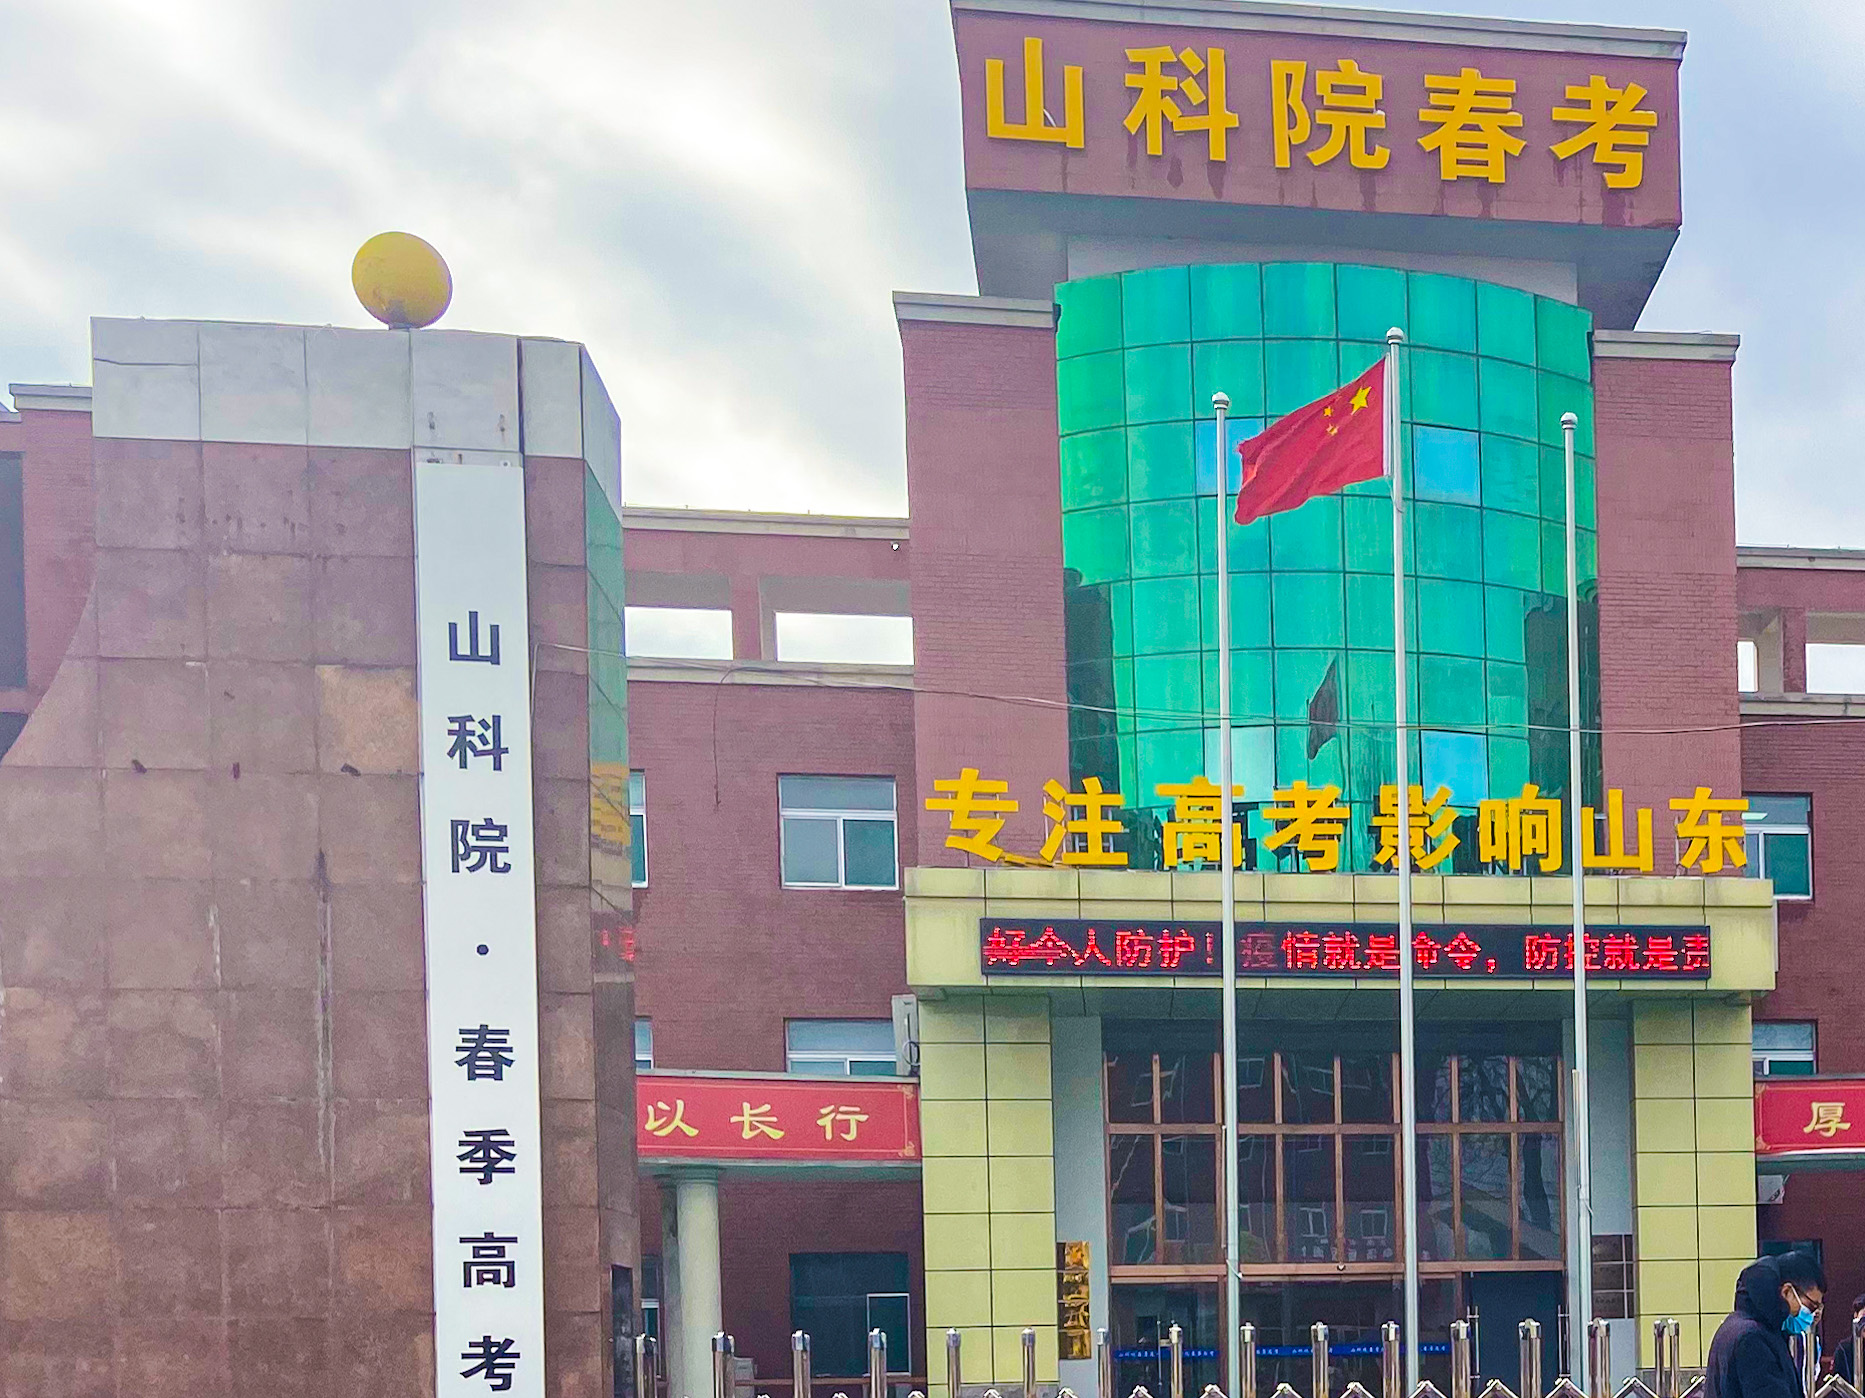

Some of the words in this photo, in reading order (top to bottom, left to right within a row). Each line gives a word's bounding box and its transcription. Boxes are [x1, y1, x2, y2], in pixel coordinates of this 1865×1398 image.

[985, 37, 1659, 190] 山科院春考
[925, 767, 1750, 875] 专注高考影响山东
[644, 1099, 870, 1141] 以长行
